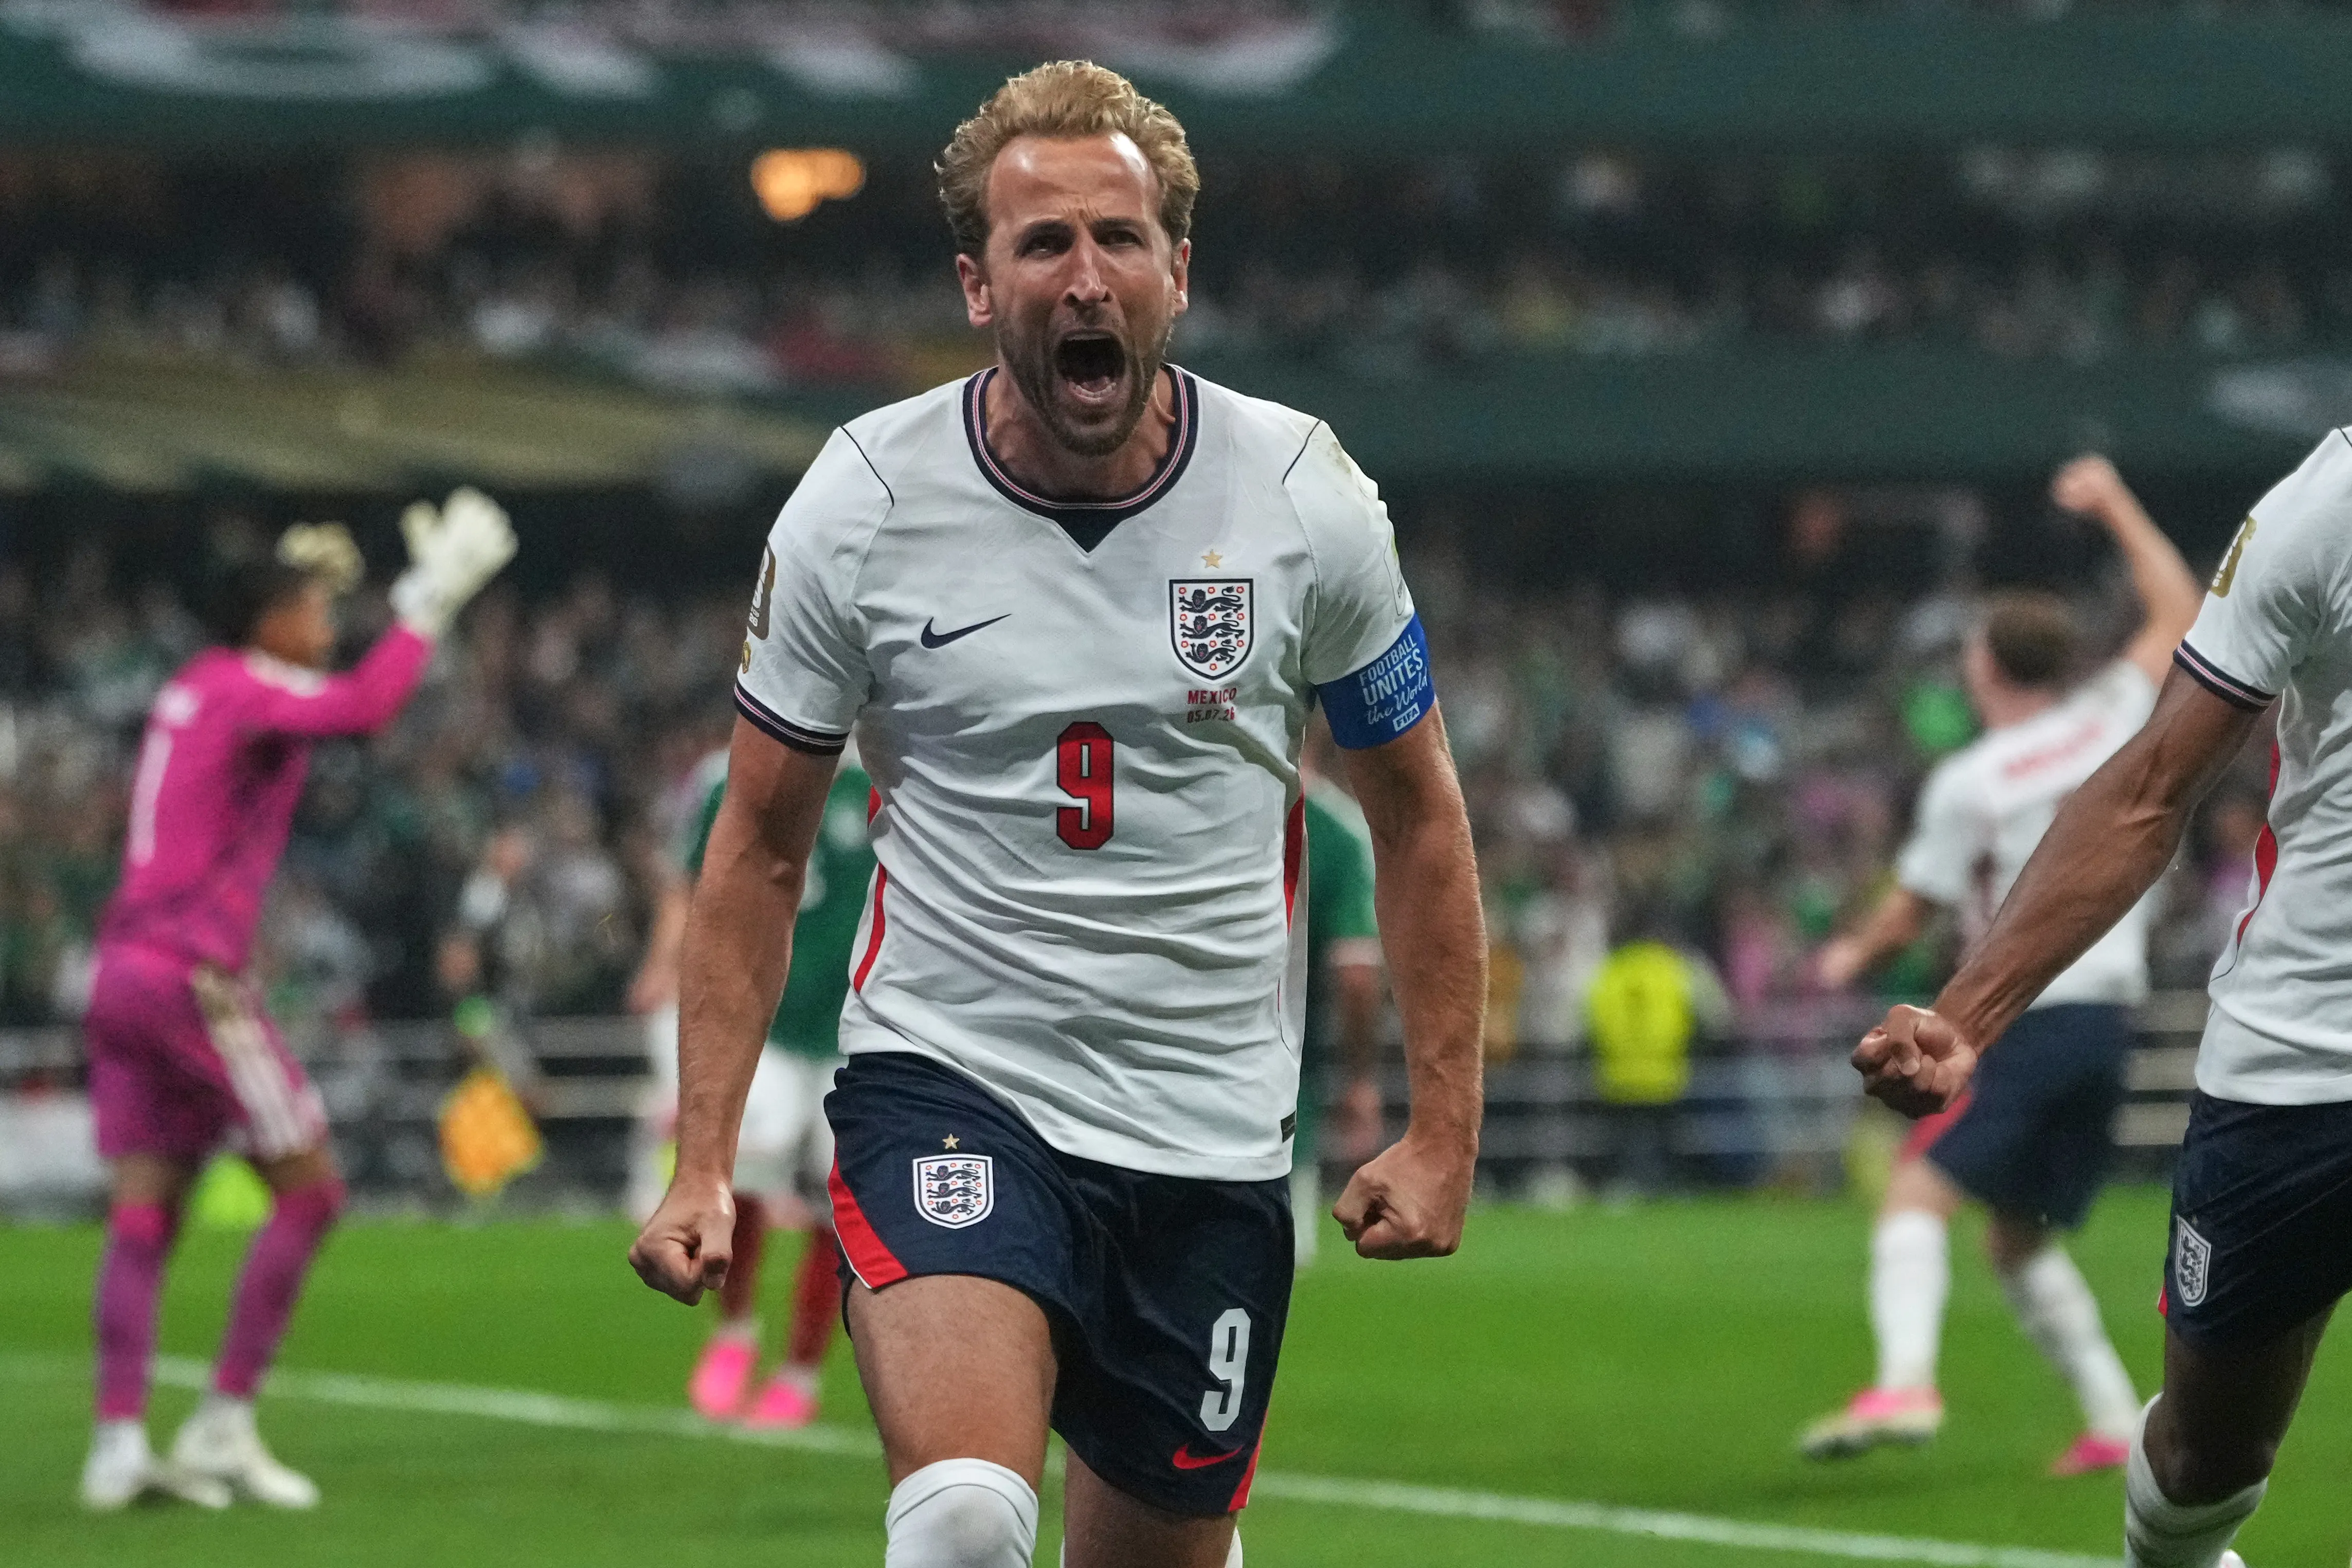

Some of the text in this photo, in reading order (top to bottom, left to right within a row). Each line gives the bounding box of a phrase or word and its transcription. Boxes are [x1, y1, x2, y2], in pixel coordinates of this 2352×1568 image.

[1359, 634, 1417, 687] FOOTBALL
[1362, 648, 1424, 706] UNITES
[1187, 687, 1237, 705] MEXICO
[1367, 666, 1428, 725] the World
[1056, 721, 1114, 850] 9
[1199, 1307, 1251, 1432] 9
